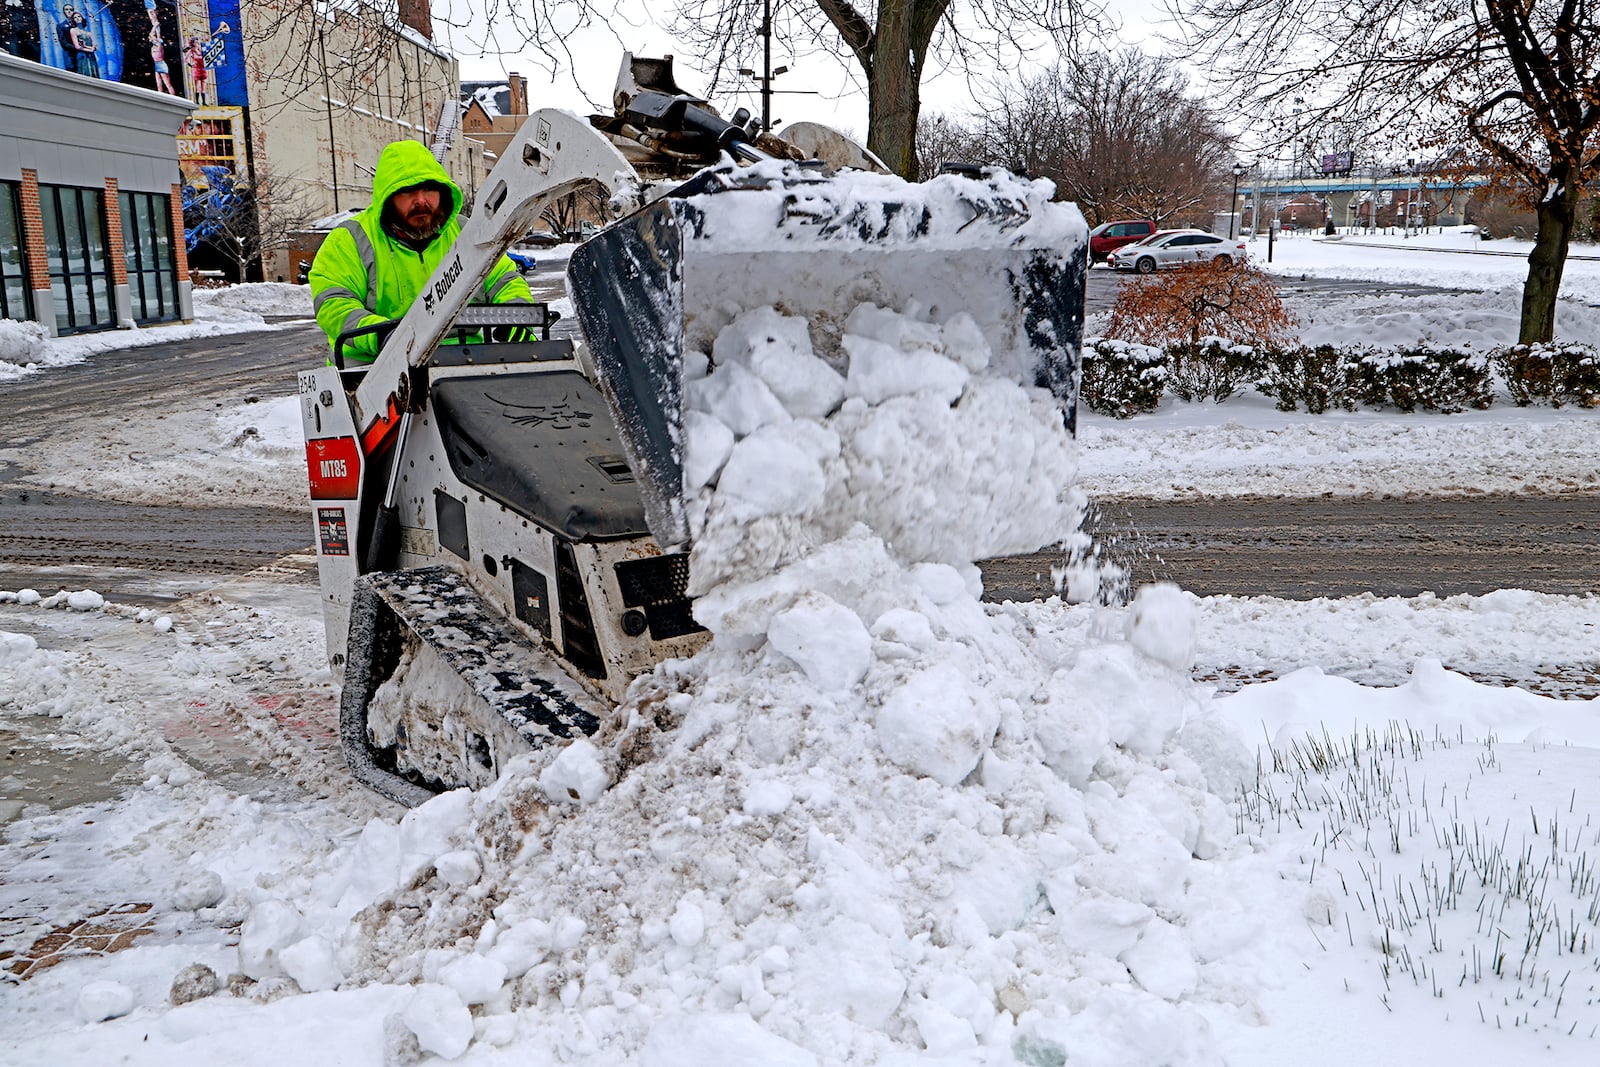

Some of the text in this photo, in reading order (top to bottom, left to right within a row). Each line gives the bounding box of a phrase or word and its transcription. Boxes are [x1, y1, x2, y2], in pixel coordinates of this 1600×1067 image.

[205, 41, 223, 63] SUN
[434, 253, 463, 302] Bobcat
[300, 375, 317, 394] 2548
[320, 459, 347, 478] MT85
